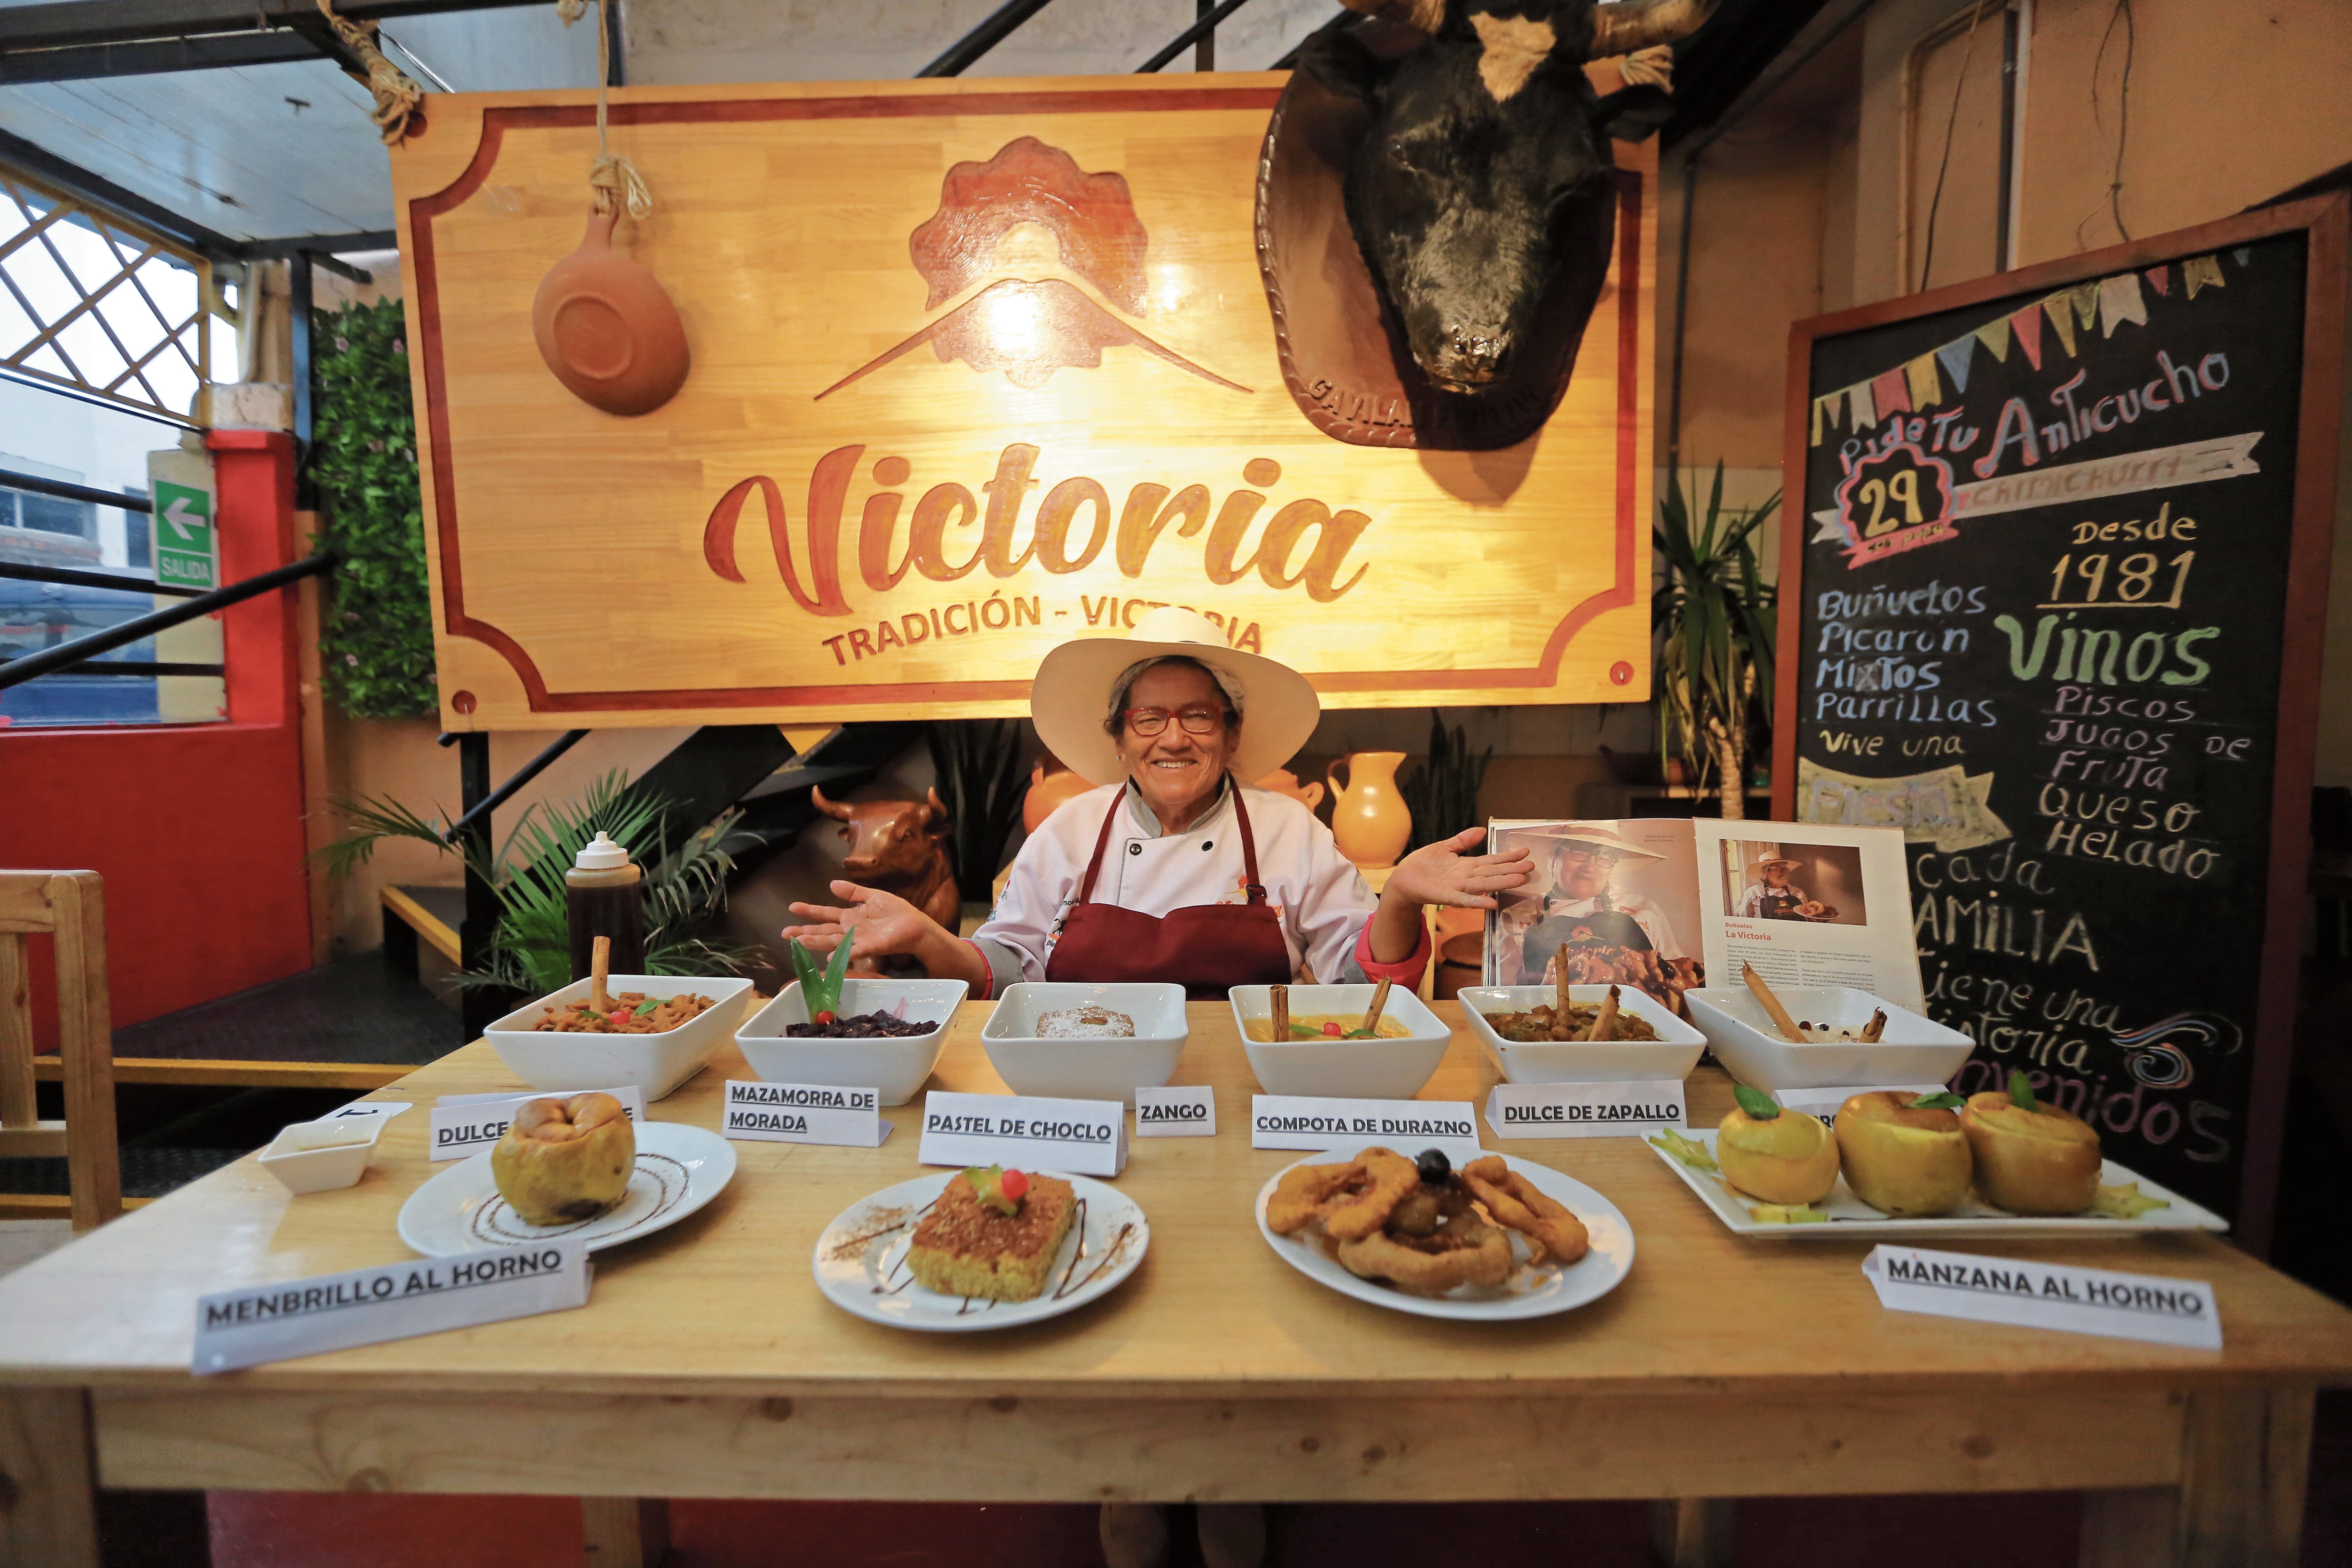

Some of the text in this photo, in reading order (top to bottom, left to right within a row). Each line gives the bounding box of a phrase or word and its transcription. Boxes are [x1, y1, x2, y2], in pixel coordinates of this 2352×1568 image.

[1858, 469, 1923, 538] 29
[703, 442, 1372, 617] Victoria
[2072, 501, 2197, 544] Desde
[161, 557, 210, 581] SALIDA
[2051, 550, 2195, 609] 1981
[822, 590, 1041, 666] TRADICIÓN
[1081, 595, 1262, 654] VICIA
[1994, 610, 2221, 686] Vinos
[2056, 685, 2195, 722] Piscos
[1819, 730, 1965, 756] Vive una
[1738, 931, 1771, 940] Victoria
[1915, 891, 2099, 972] AMILIA
[731, 1086, 874, 1108] MAZAMORRA DE
[1141, 1104, 1206, 1122] ZANGO
[1505, 1104, 1680, 1122] DULCE DE ZAPALLO
[438, 1120, 509, 1144] DULCE
[730, 1112, 807, 1131] MORADA
[928, 1114, 1112, 1141] PASTEL DE CHOCLO
[1256, 1116, 1472, 1136] COMPOTA DE DURAZNO
[207, 1249, 562, 1327] MENBRILLO AL HORNO
[1887, 1257, 2203, 1316] MANZANA AL HORNO
